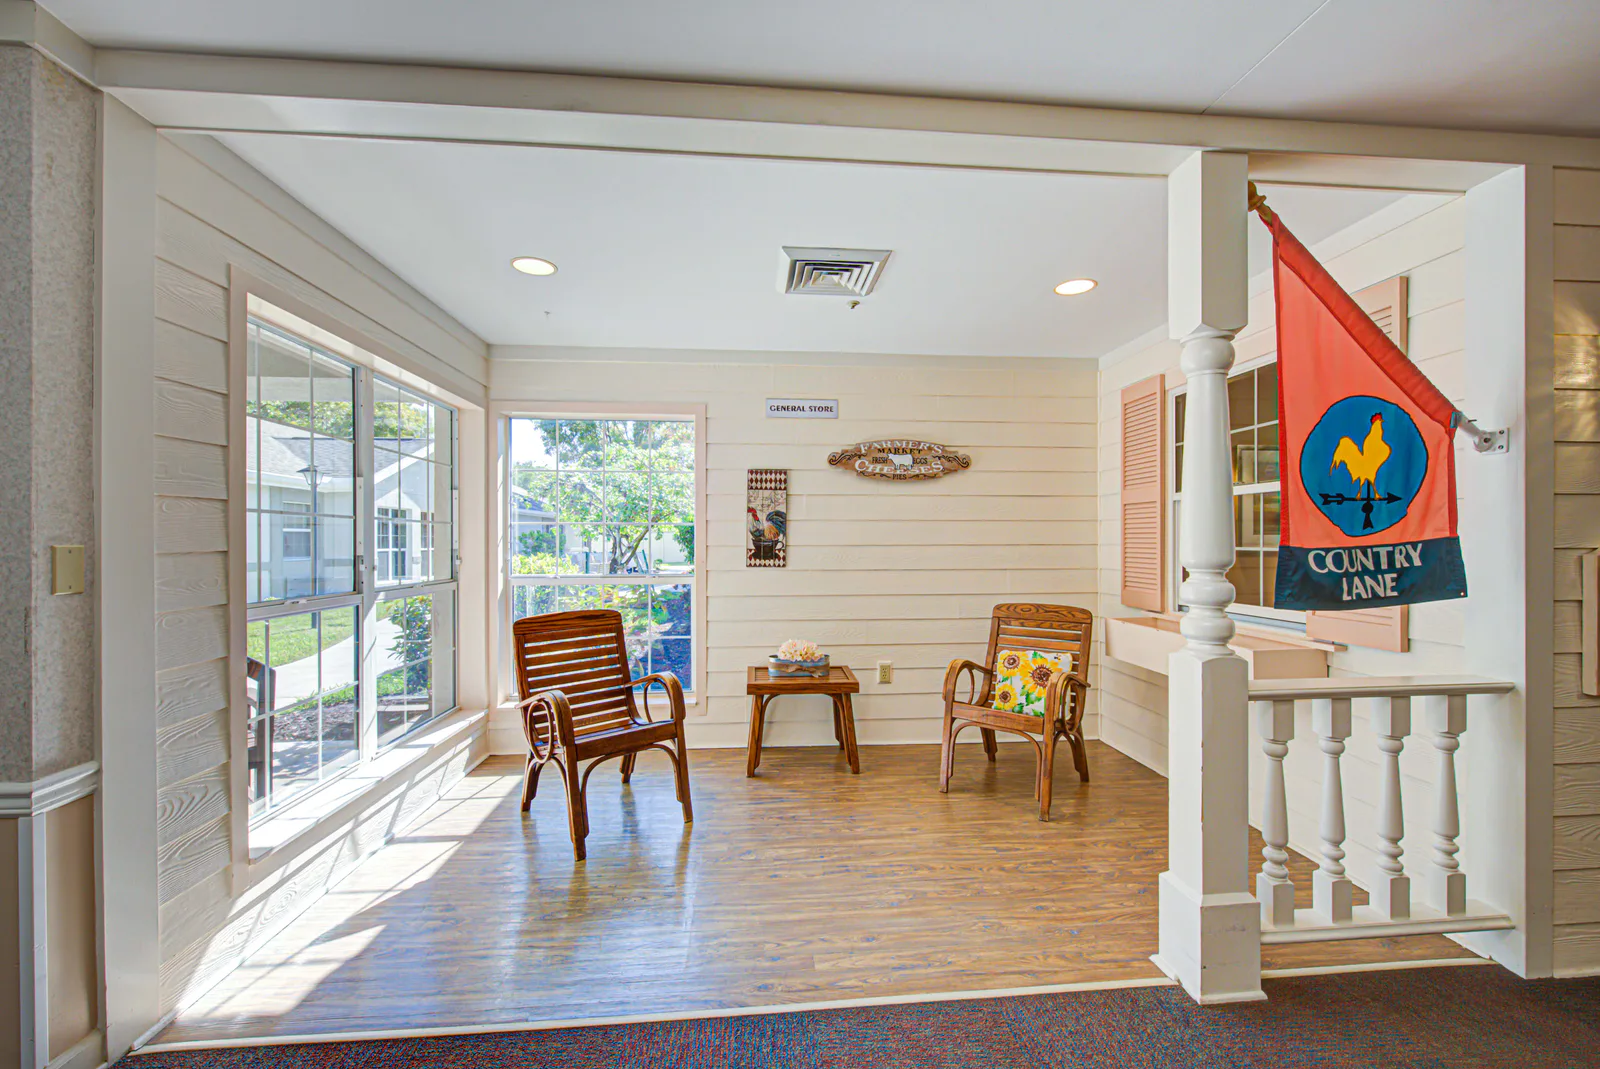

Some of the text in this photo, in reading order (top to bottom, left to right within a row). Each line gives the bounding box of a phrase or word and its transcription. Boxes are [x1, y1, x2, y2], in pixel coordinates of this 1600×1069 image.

[769, 404, 807, 412] GENERAL
[860, 440, 944, 455] FARMER'S
[877, 447, 923, 455] MARKET
[871, 456, 928, 465] FRESH EGGS
[854, 459, 945, 475] CHEESES
[892, 473, 907, 481] PIES
[1307, 543, 1423, 574] COUNTRY
[1342, 573, 1399, 601] LANE
